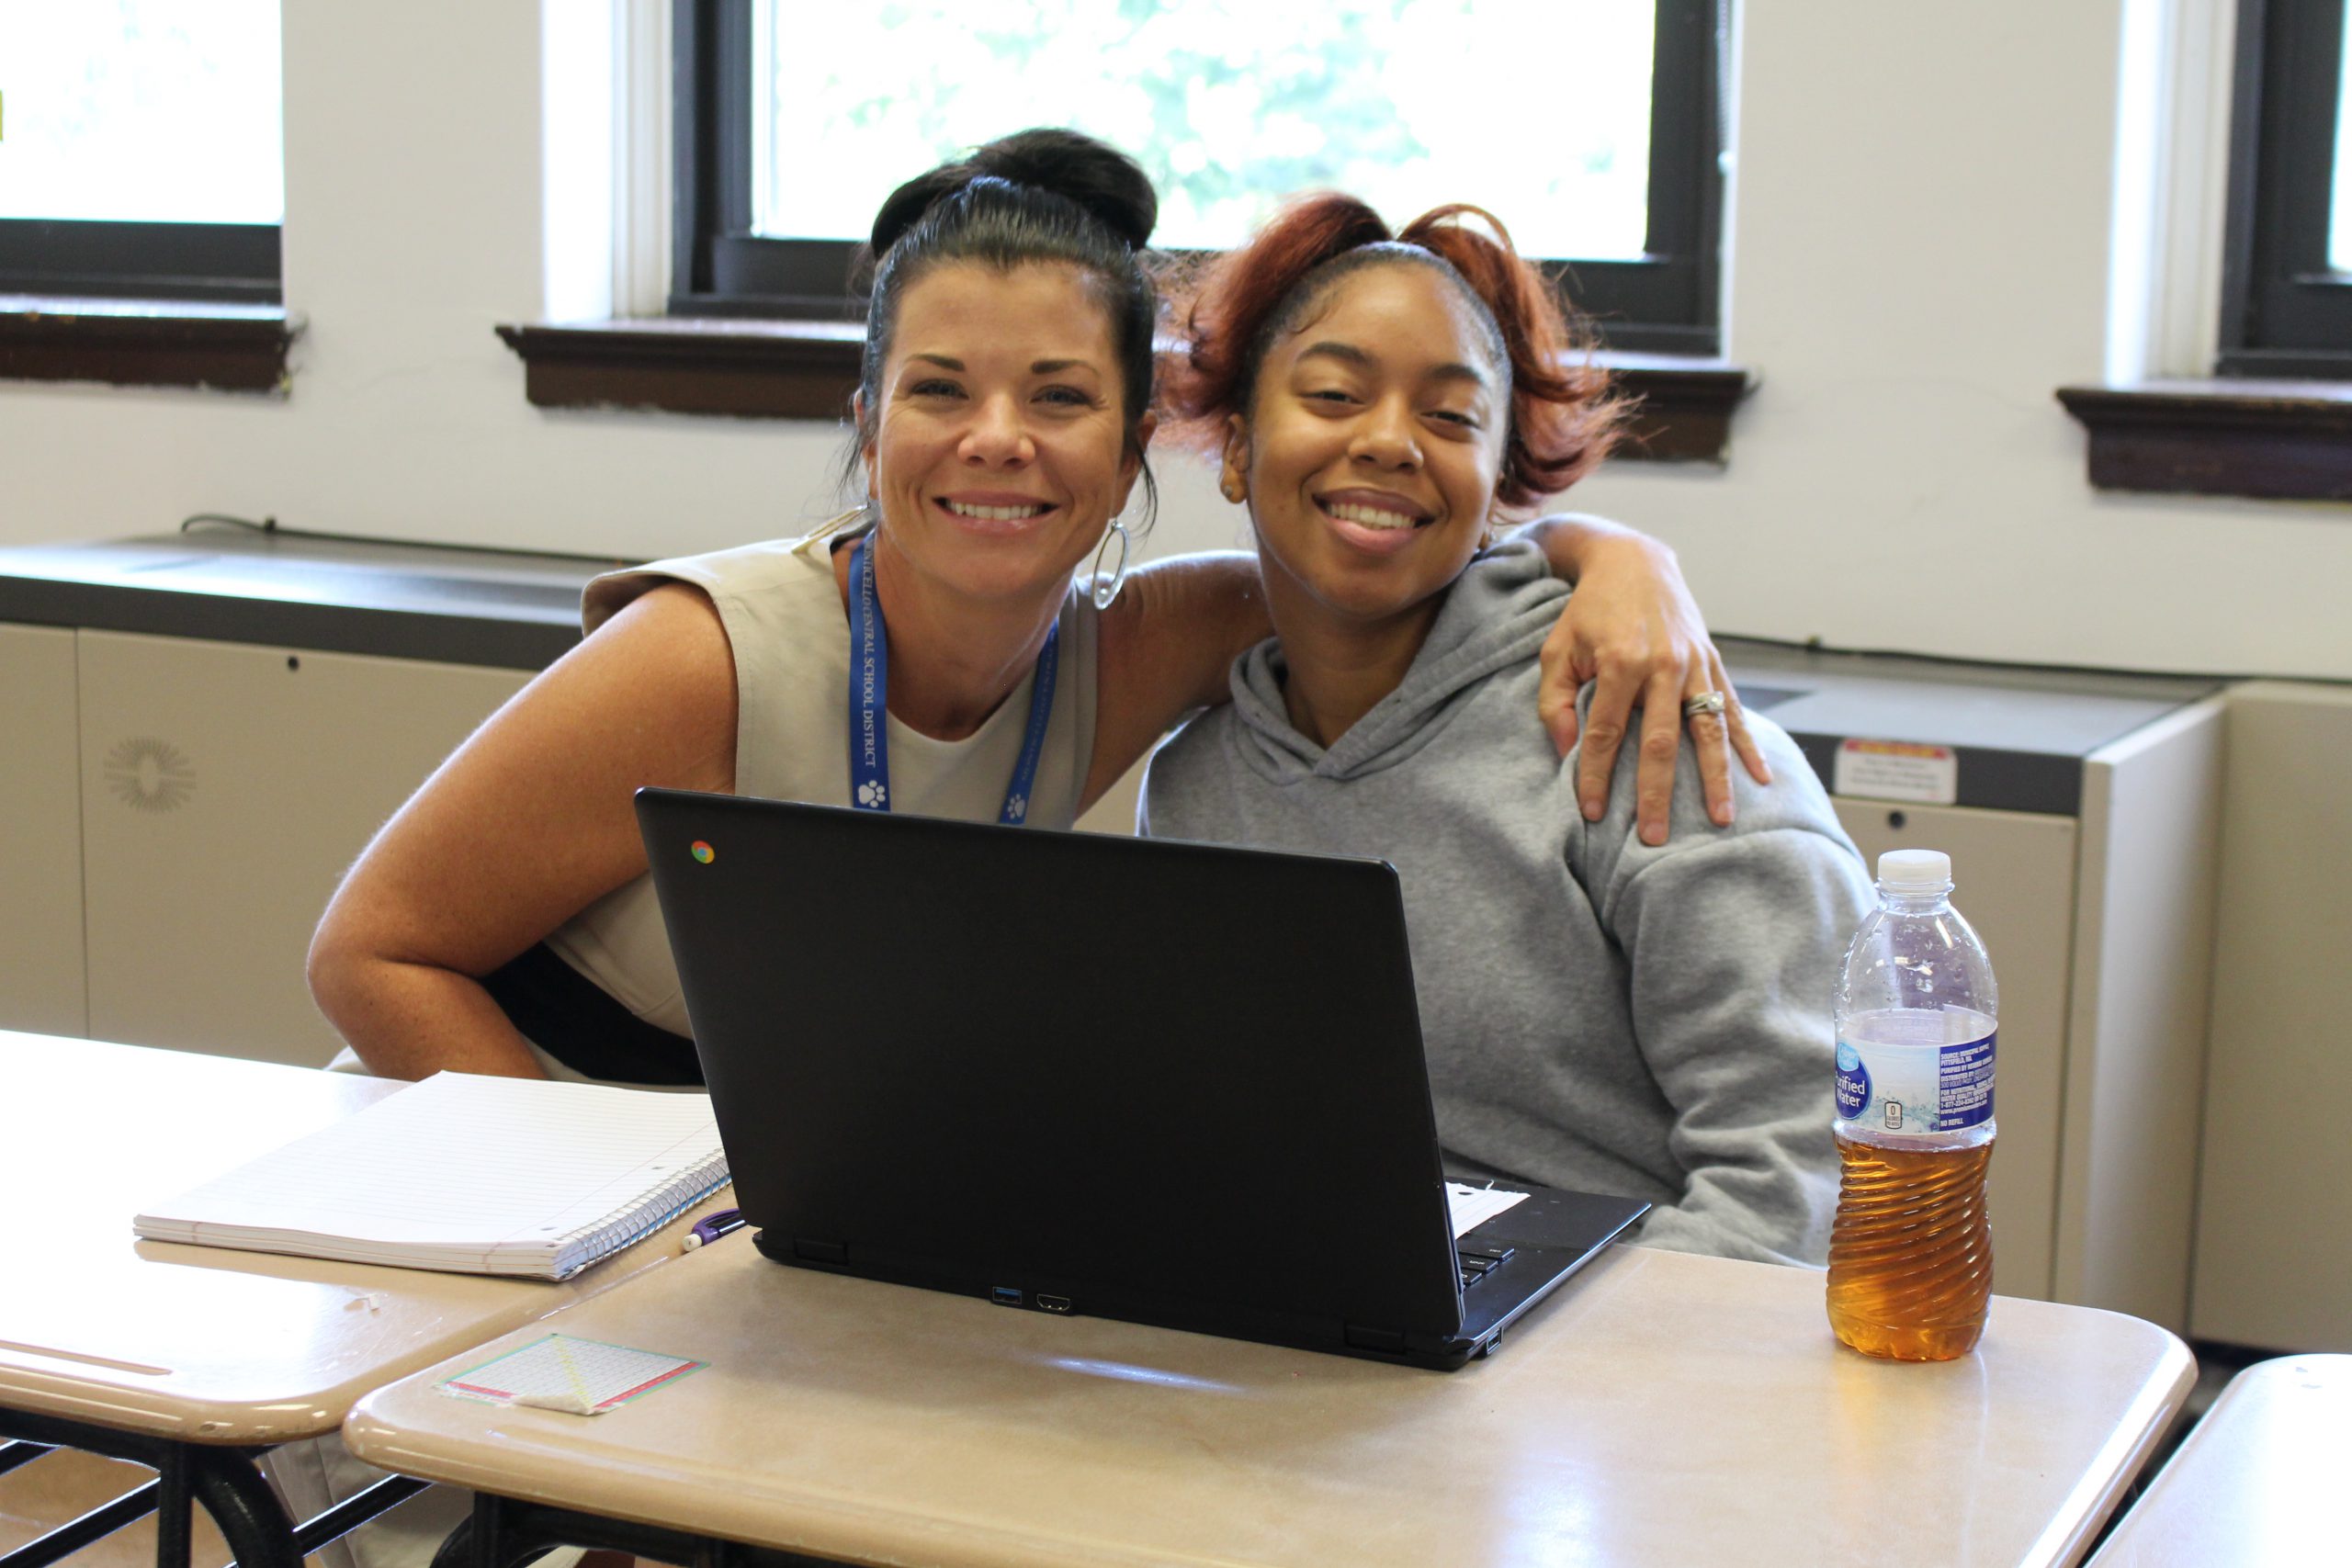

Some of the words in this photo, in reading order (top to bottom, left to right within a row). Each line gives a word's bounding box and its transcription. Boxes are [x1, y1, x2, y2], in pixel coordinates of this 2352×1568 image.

[862, 606, 875, 655] CENTRAL
[863, 657, 876, 707] SCHOOL
[863, 710, 876, 768] DISTRICT
[1836, 1071, 1866, 1095] urified
[1890, 1105, 1896, 1116] 0
[1949, 1118, 1963, 1126] REFILL
